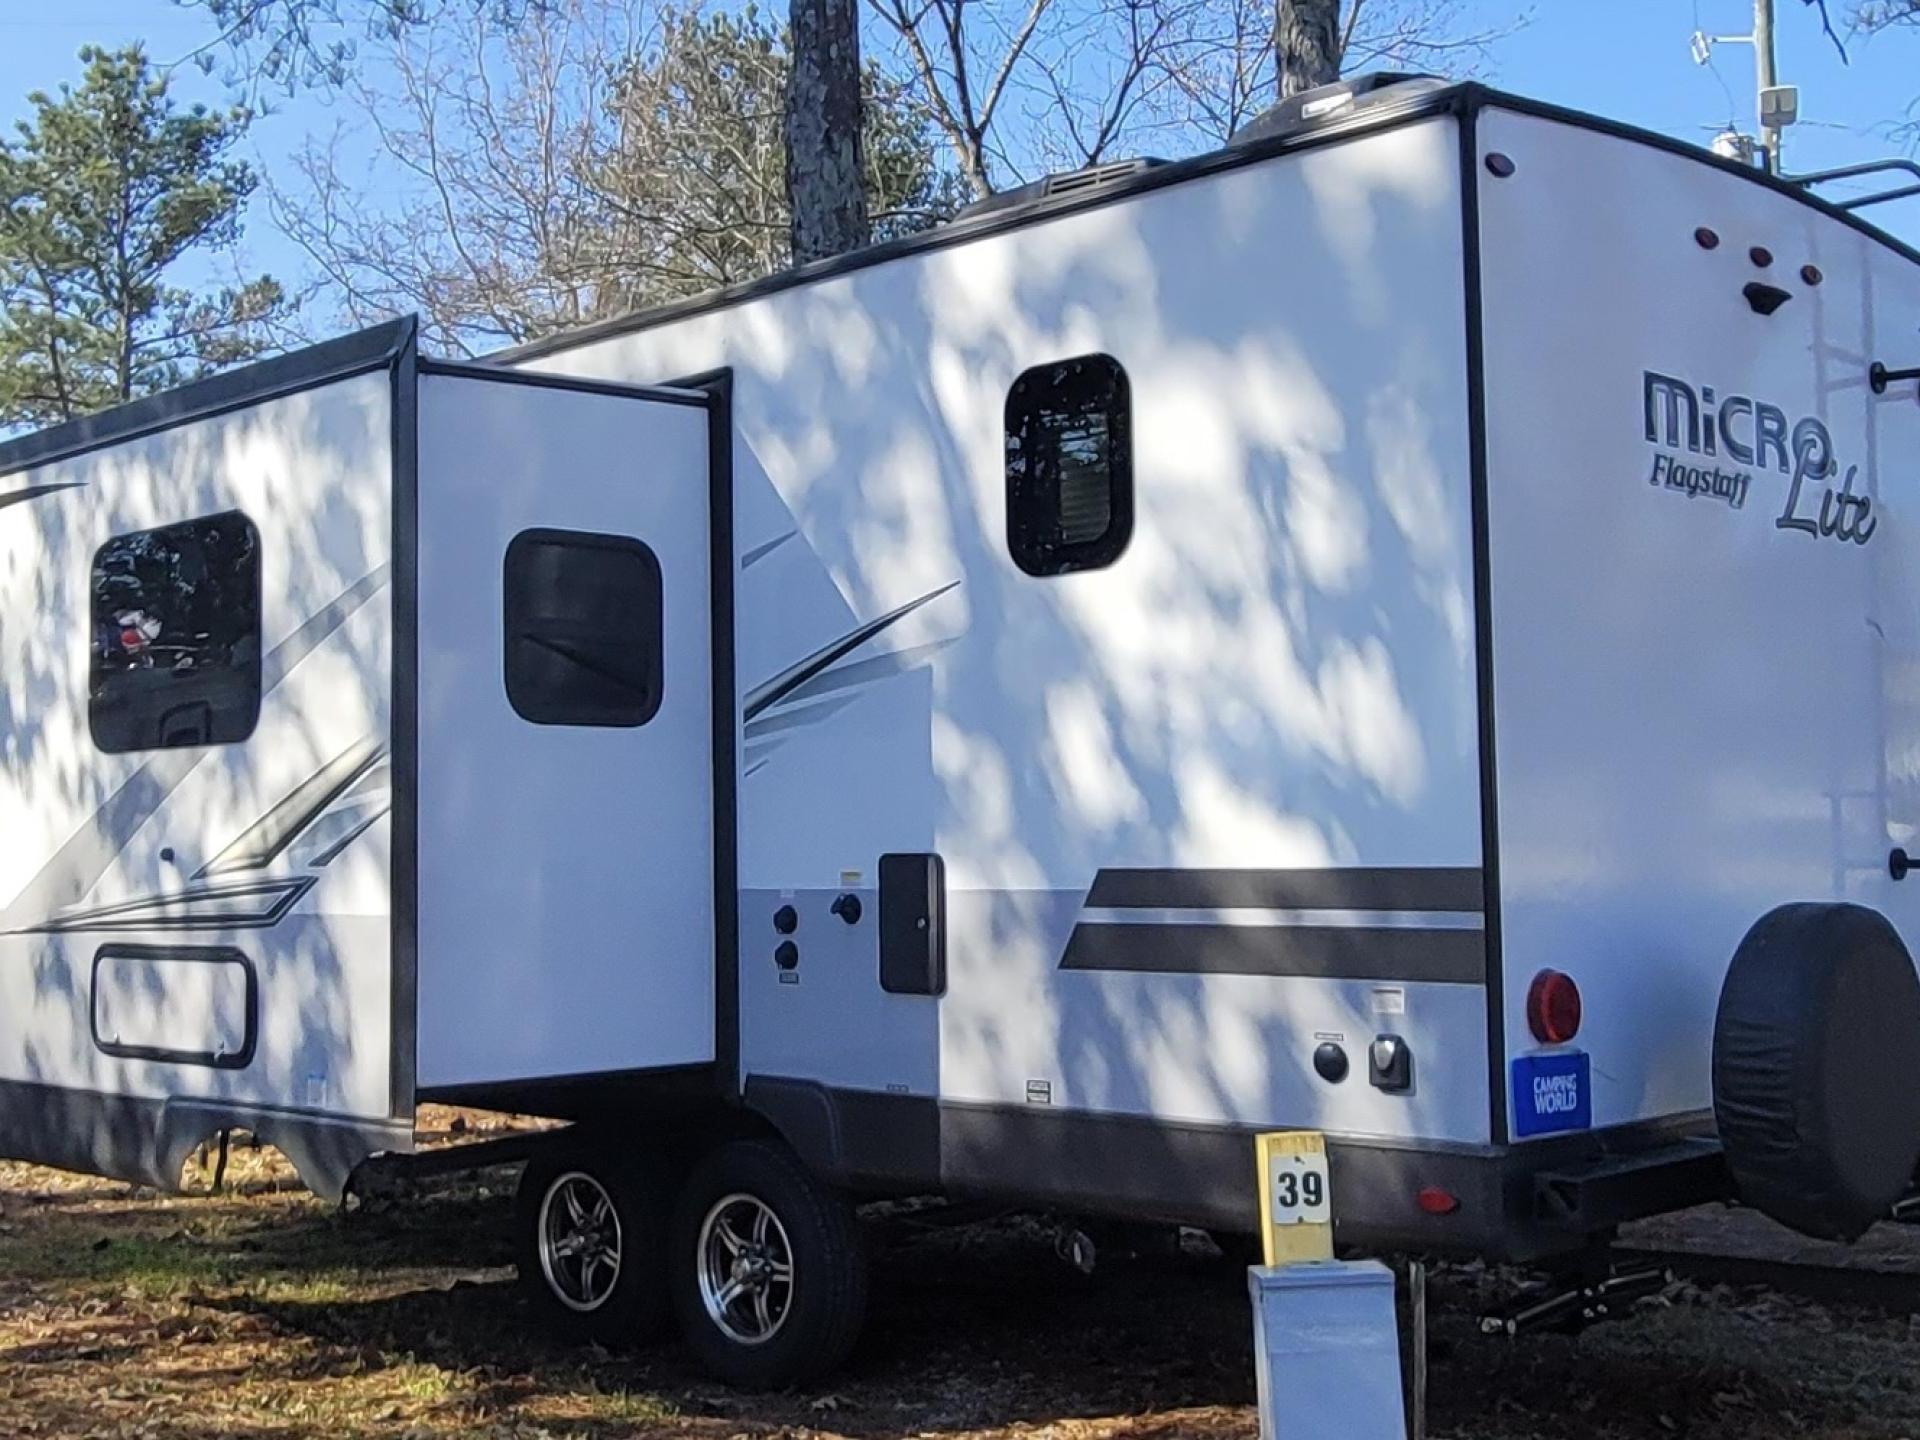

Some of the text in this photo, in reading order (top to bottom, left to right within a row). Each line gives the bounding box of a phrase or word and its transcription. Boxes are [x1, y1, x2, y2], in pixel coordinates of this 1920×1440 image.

[1650, 453, 1751, 509] Flagstaff
[1776, 438, 1877, 545] Lite
[1534, 1091, 1577, 1114] WORLD
[1277, 1171, 1323, 1208] 39
